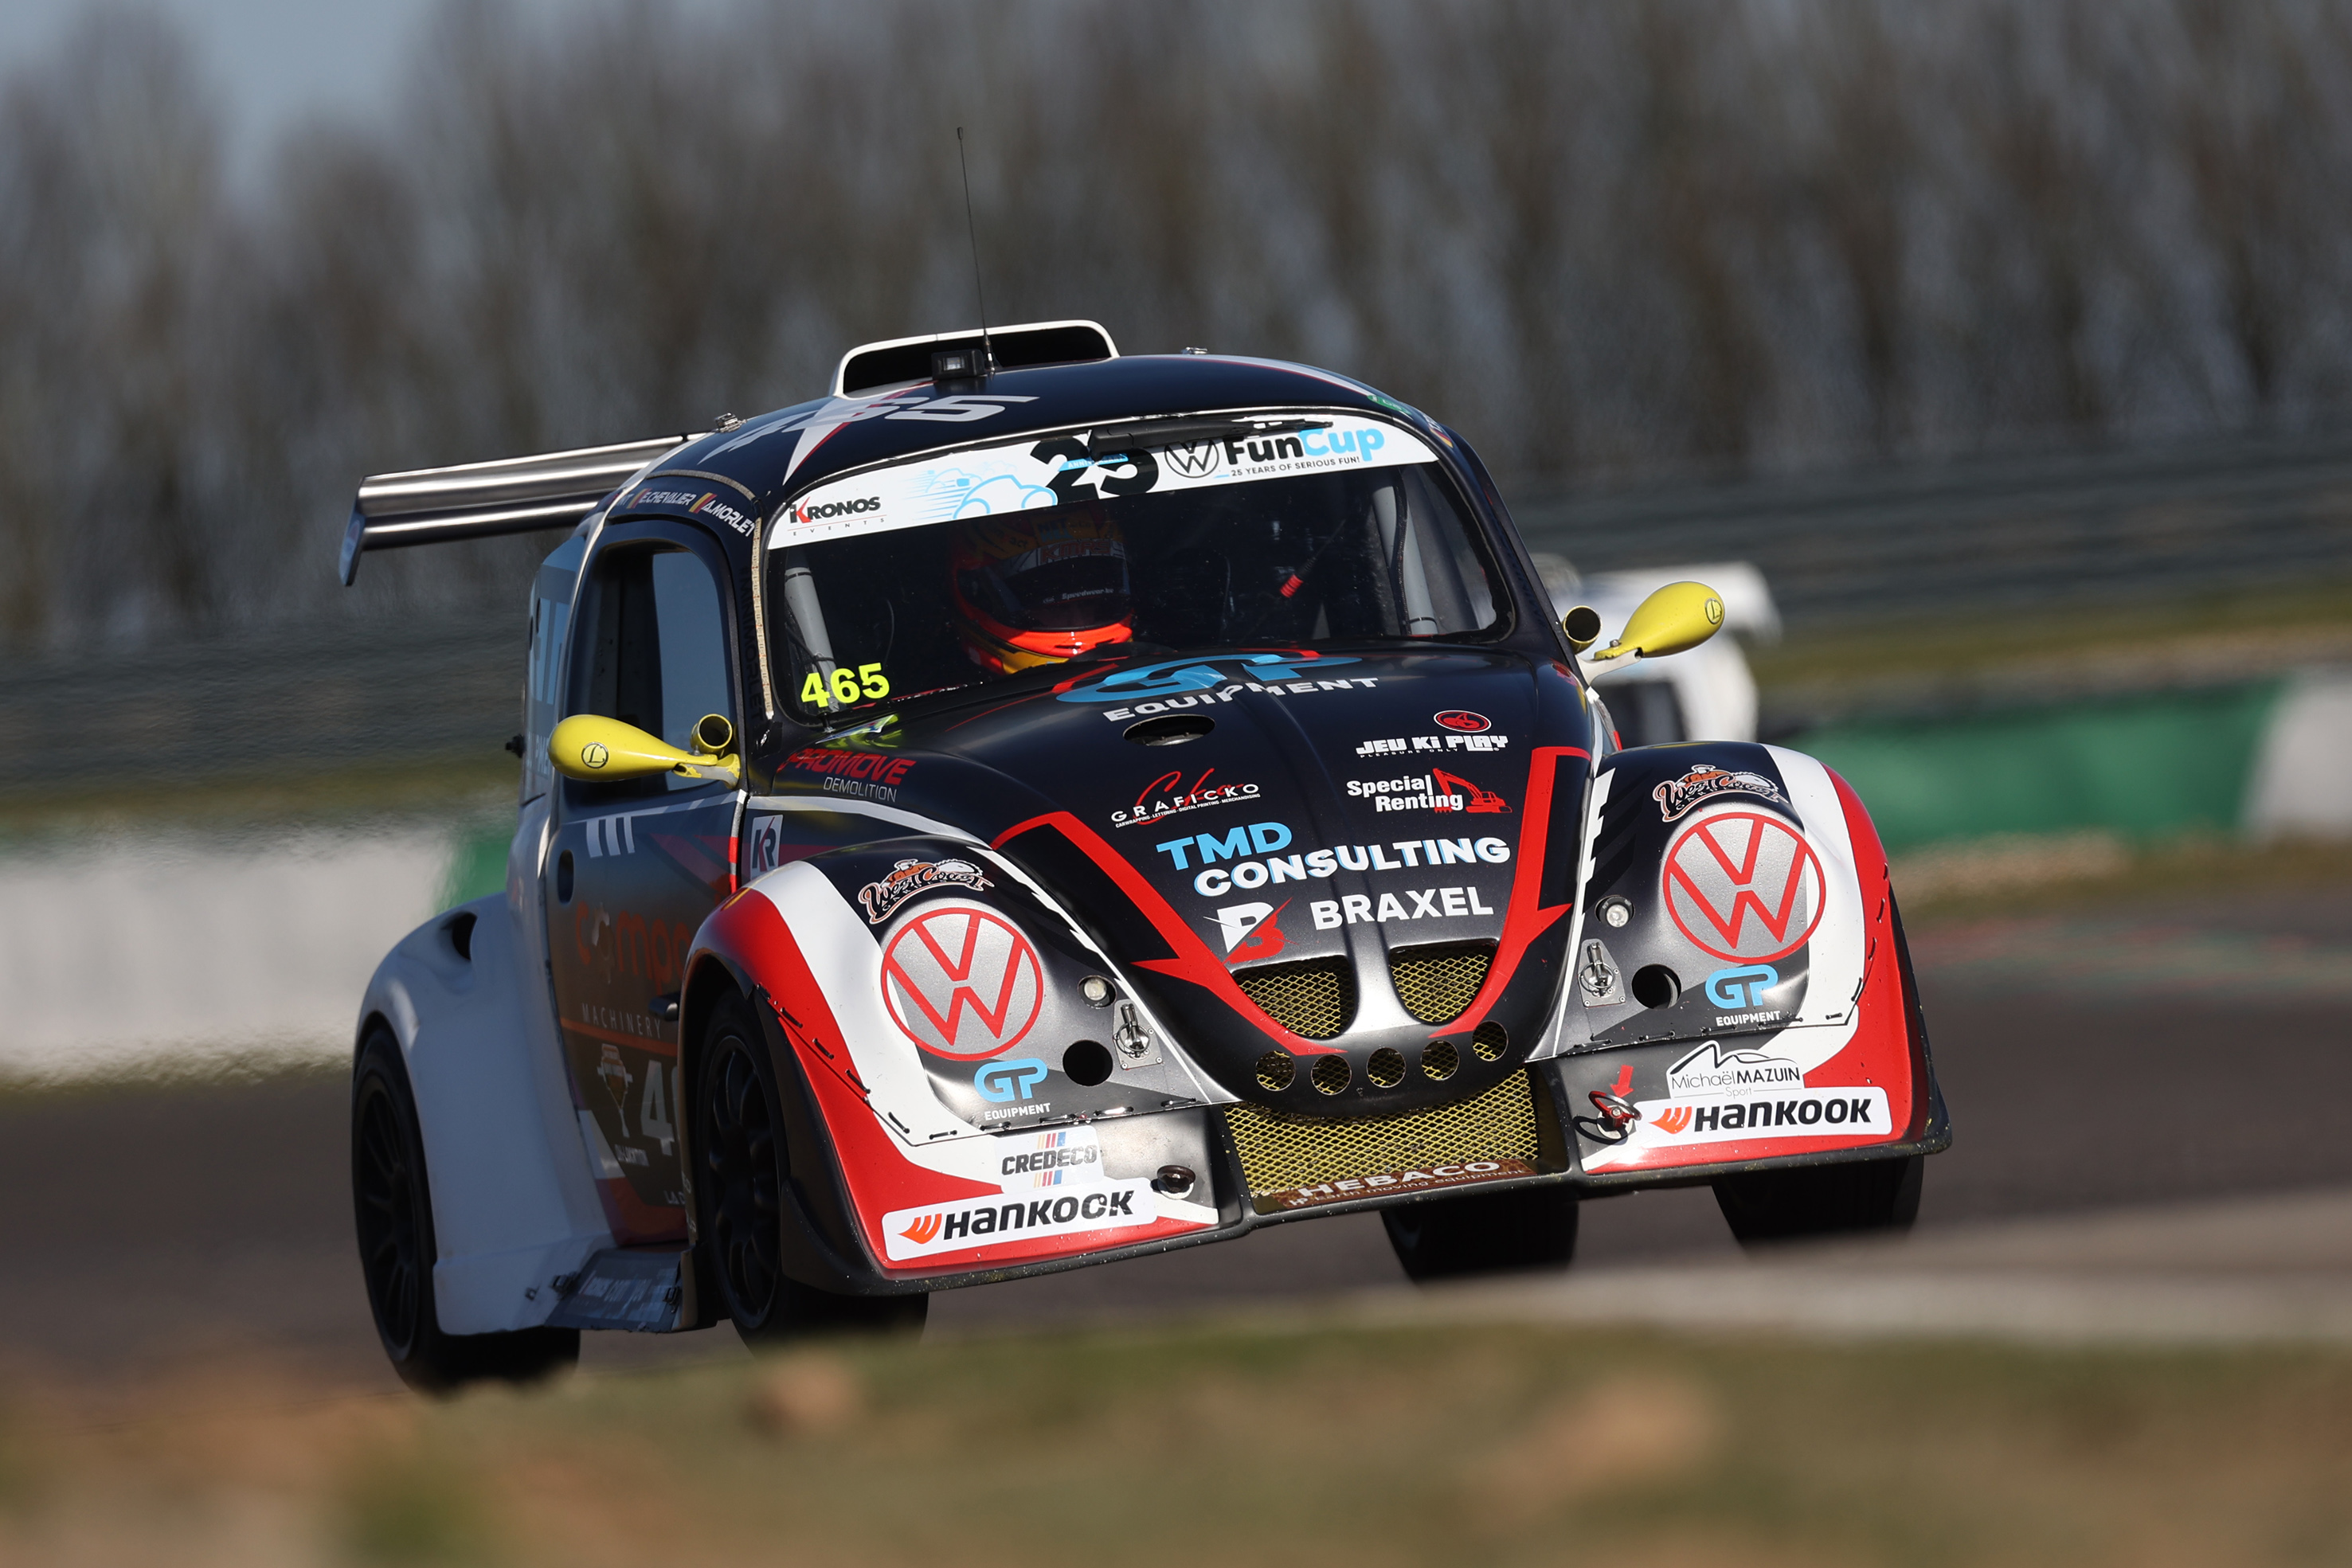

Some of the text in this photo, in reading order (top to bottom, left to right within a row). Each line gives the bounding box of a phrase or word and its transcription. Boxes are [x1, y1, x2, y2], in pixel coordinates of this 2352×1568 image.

[1223, 426, 1385, 465] FunCup
[1245, 465, 1276, 475] YEARS
[1294, 459, 1336, 469] SERIOUS
[1339, 456, 1360, 465] FUN!
[789, 496, 881, 524] KRONOS
[792, 518, 885, 536] EVENTS
[800, 663, 890, 708] 465
[1056, 653, 1363, 703] GP
[1102, 677, 1379, 721] EQUIPMENT
[1356, 737, 1407, 755] JEU
[1360, 749, 1422, 758] PLEASURE
[777, 748, 917, 785] PROMOVE
[824, 776, 898, 803] DEMOLITION
[1346, 774, 1434, 798] Special
[1376, 792, 1464, 812] Renting
[1111, 783, 1259, 823] GRAFICKO
[1197, 800, 1220, 808] PRINTING
[1156, 821, 1293, 870] TMD
[1194, 837, 1511, 897] CONSULTING
[1310, 886, 1494, 931] BRAXEL
[1704, 964, 1779, 1010] GP
[581, 1003, 662, 1039] MACHINERY
[1716, 1011, 1782, 1026] EQUIPMENT
[973, 1057, 1049, 1103] GP
[1725, 1085, 1753, 1100] Sport
[984, 1102, 1051, 1121] EQUIPMENT
[1001, 1144, 1098, 1176] CREDECO
[1298, 1161, 1500, 1198] HEBACO
[1367, 1180, 1429, 1195] moving
[1438, 1168, 1526, 1184] equipment
